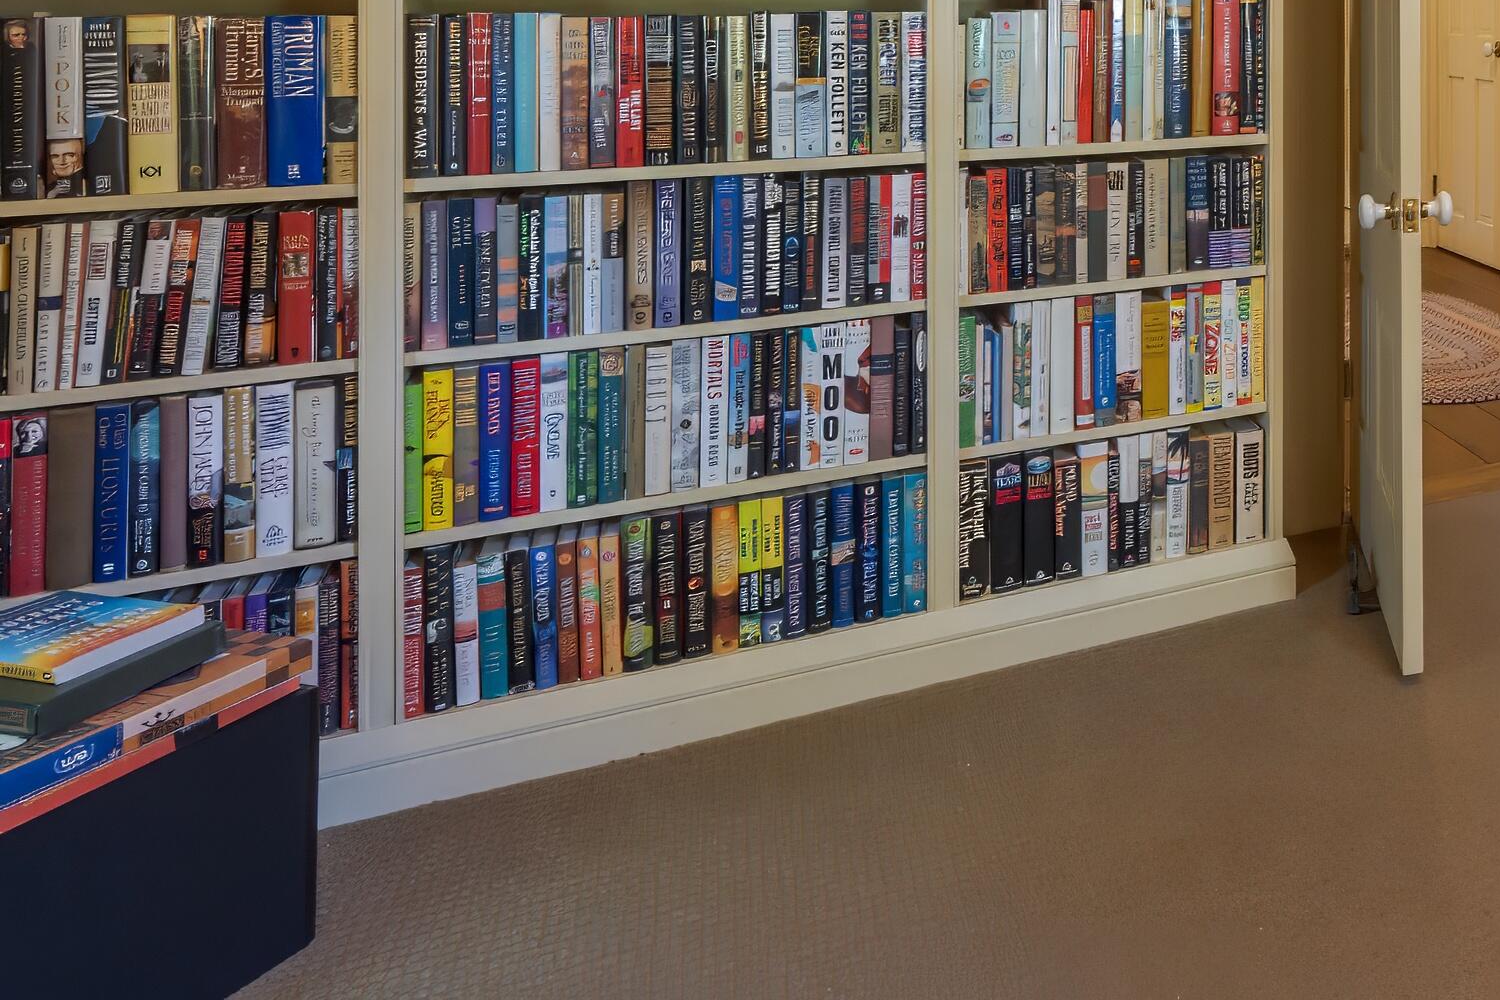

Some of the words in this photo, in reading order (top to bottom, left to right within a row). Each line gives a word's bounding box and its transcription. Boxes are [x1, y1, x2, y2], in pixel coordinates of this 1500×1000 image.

[241, 21, 264, 65] Harry
[284, 21, 315, 96] TRUMAN
[831, 43, 844, 70] KEN
[852, 45, 867, 70] KEN
[414, 32, 427, 114] PRESIDENTS
[831, 76, 844, 135] FOLLETT
[852, 77, 867, 132] FOLLETT
[415, 128, 427, 159] WAR
[481, 231, 491, 264] ANNE
[765, 212, 781, 261] THUNDER
[481, 269, 491, 309] TYLER
[707, 340, 724, 400] MORTALS
[1205, 323, 1220, 376] ZONE
[645, 353, 668, 424] AUGUST
[822, 353, 842, 441] MOO
[193, 405, 213, 448] JOHN
[426, 391, 439, 439] FRANCIS
[513, 394, 536, 441] FRANCIS
[544, 413, 564, 460] CONCLAVE
[191, 452, 213, 492] JAKES
[274, 456, 288, 496] GORE
[1214, 437, 1232, 511] REMBRANDT
[1243, 442, 1259, 479] ROOTS
